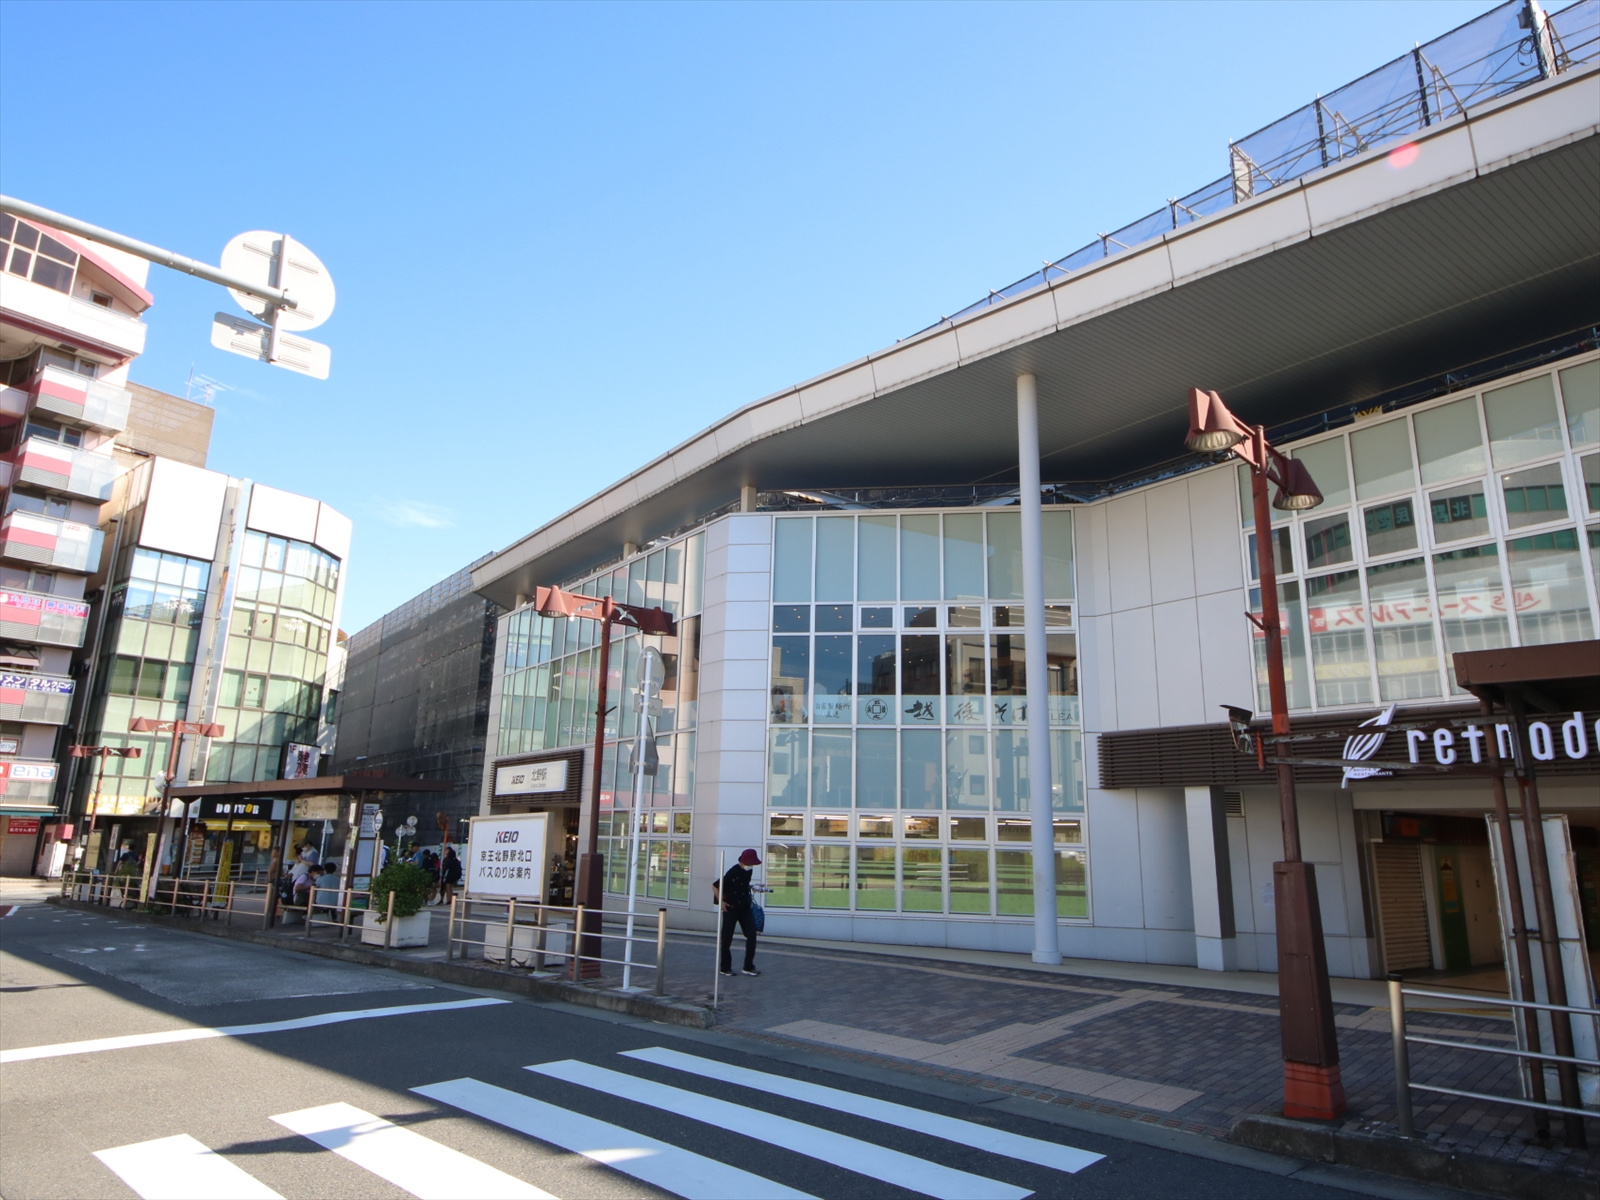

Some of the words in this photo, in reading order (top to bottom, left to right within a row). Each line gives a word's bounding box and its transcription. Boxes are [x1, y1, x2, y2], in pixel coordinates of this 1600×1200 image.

[13, 766, 55, 778] ena
[302, 799, 309, 816] 3
[495, 831, 519, 843] KEIO
[480, 850, 532, 863] 京王北野駅北口
[479, 866, 531, 880] バスのりば案内
